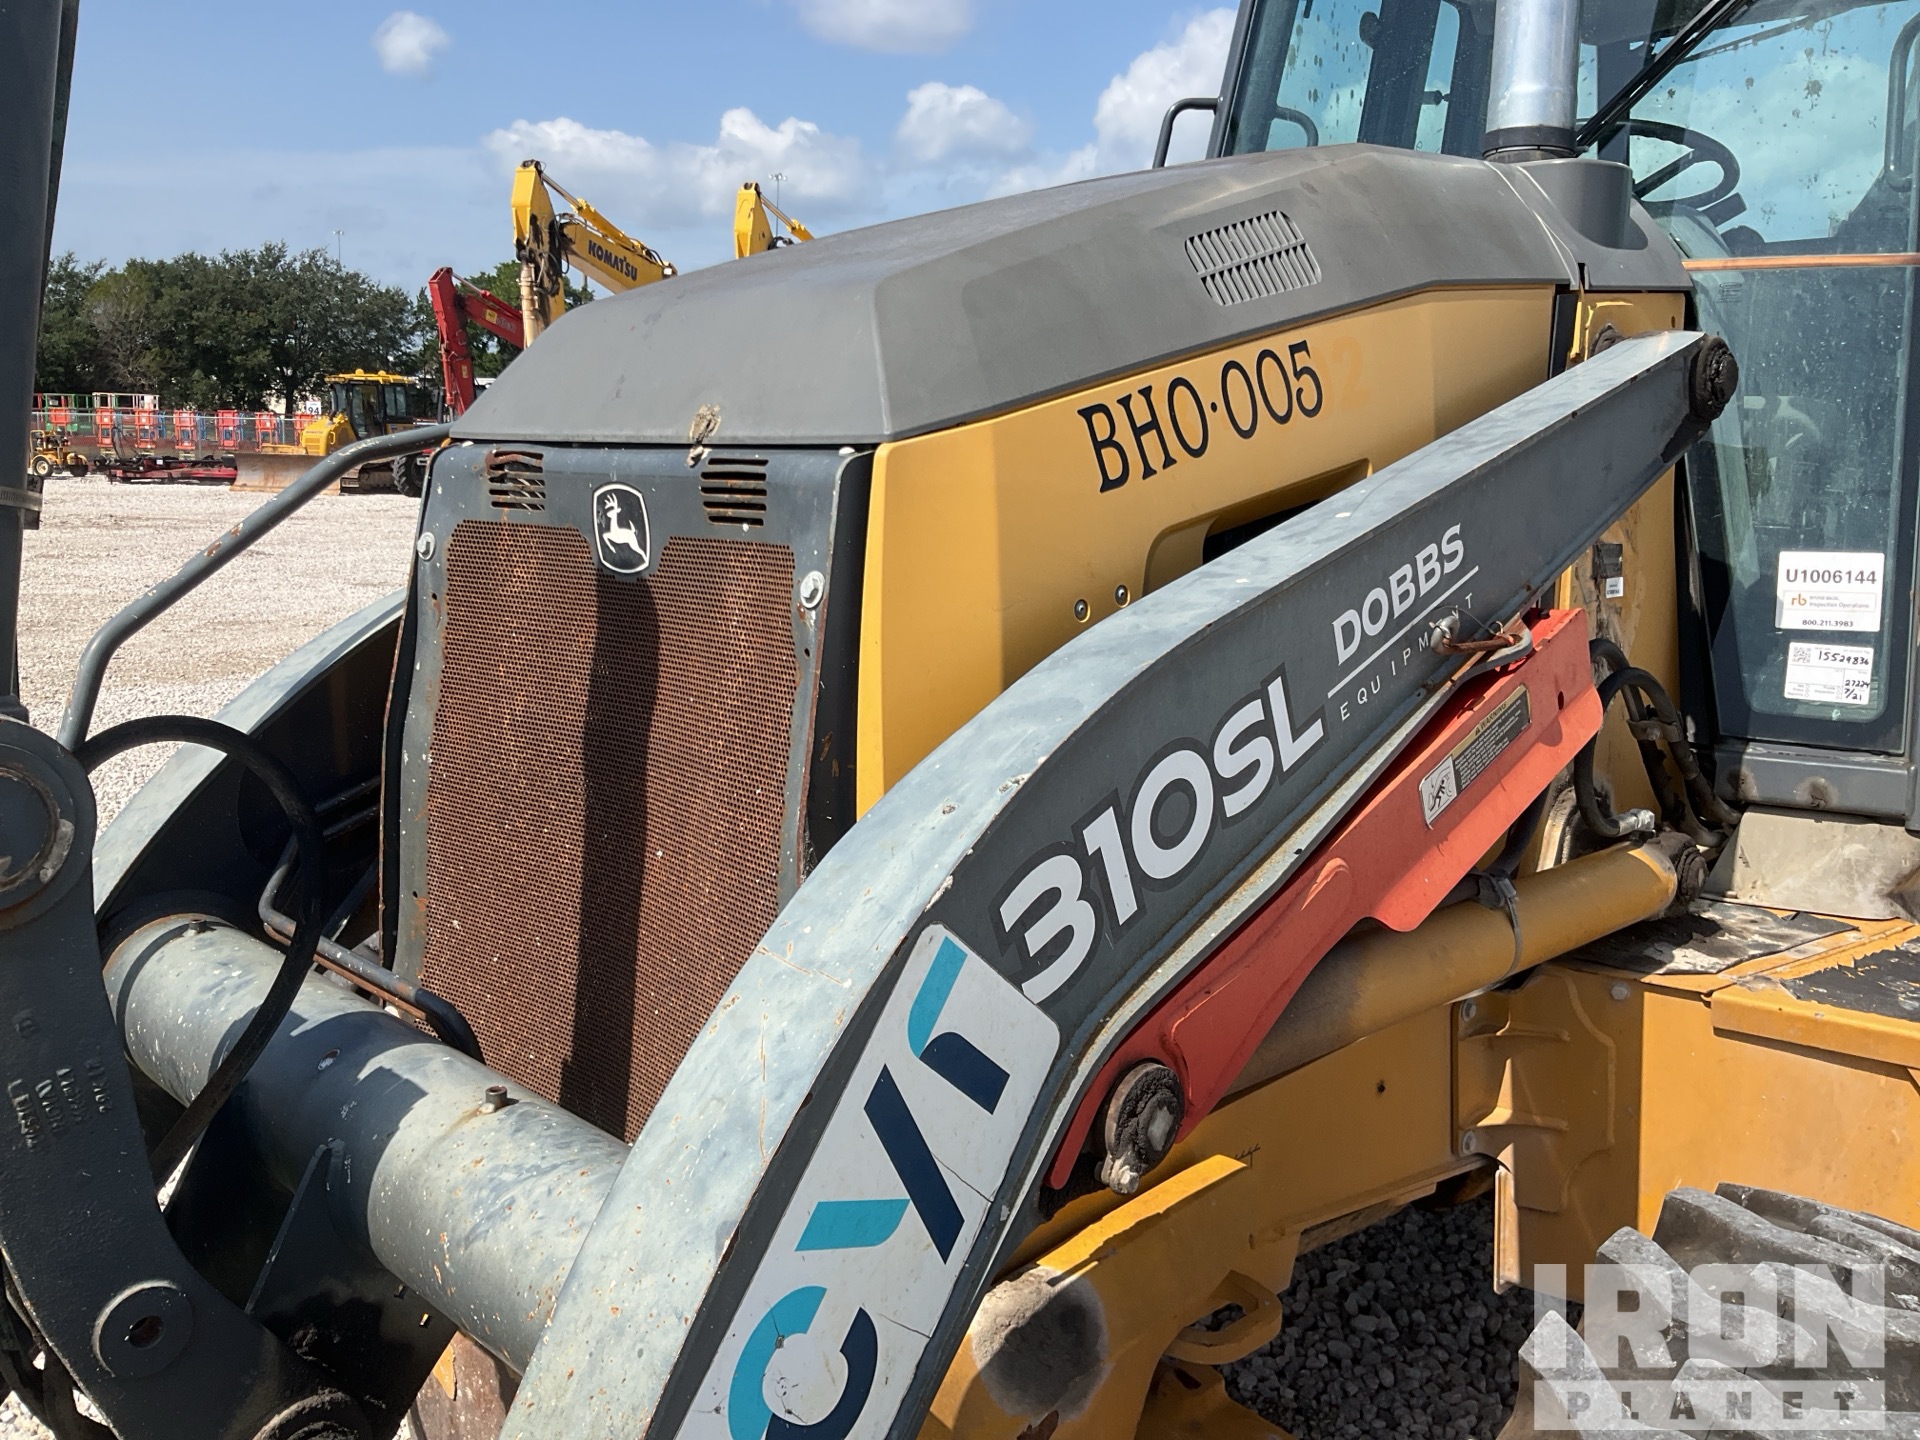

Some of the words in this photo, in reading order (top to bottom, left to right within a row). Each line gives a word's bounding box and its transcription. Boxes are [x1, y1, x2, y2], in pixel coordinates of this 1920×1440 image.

[588, 240, 638, 282] KOMATSU
[307, 406, 320, 416] 94
[1785, 568, 1877, 585] U1006144
[1331, 522, 1465, 667] DOBBS
[1809, 601, 1838, 609] Inspection
[1802, 619, 1854, 628] 800.211.3983
[1340, 592, 1473, 722] EQUIPMNT
[1480, 702, 1507, 731] WARNING
[999, 675, 1325, 1005] 310SL
